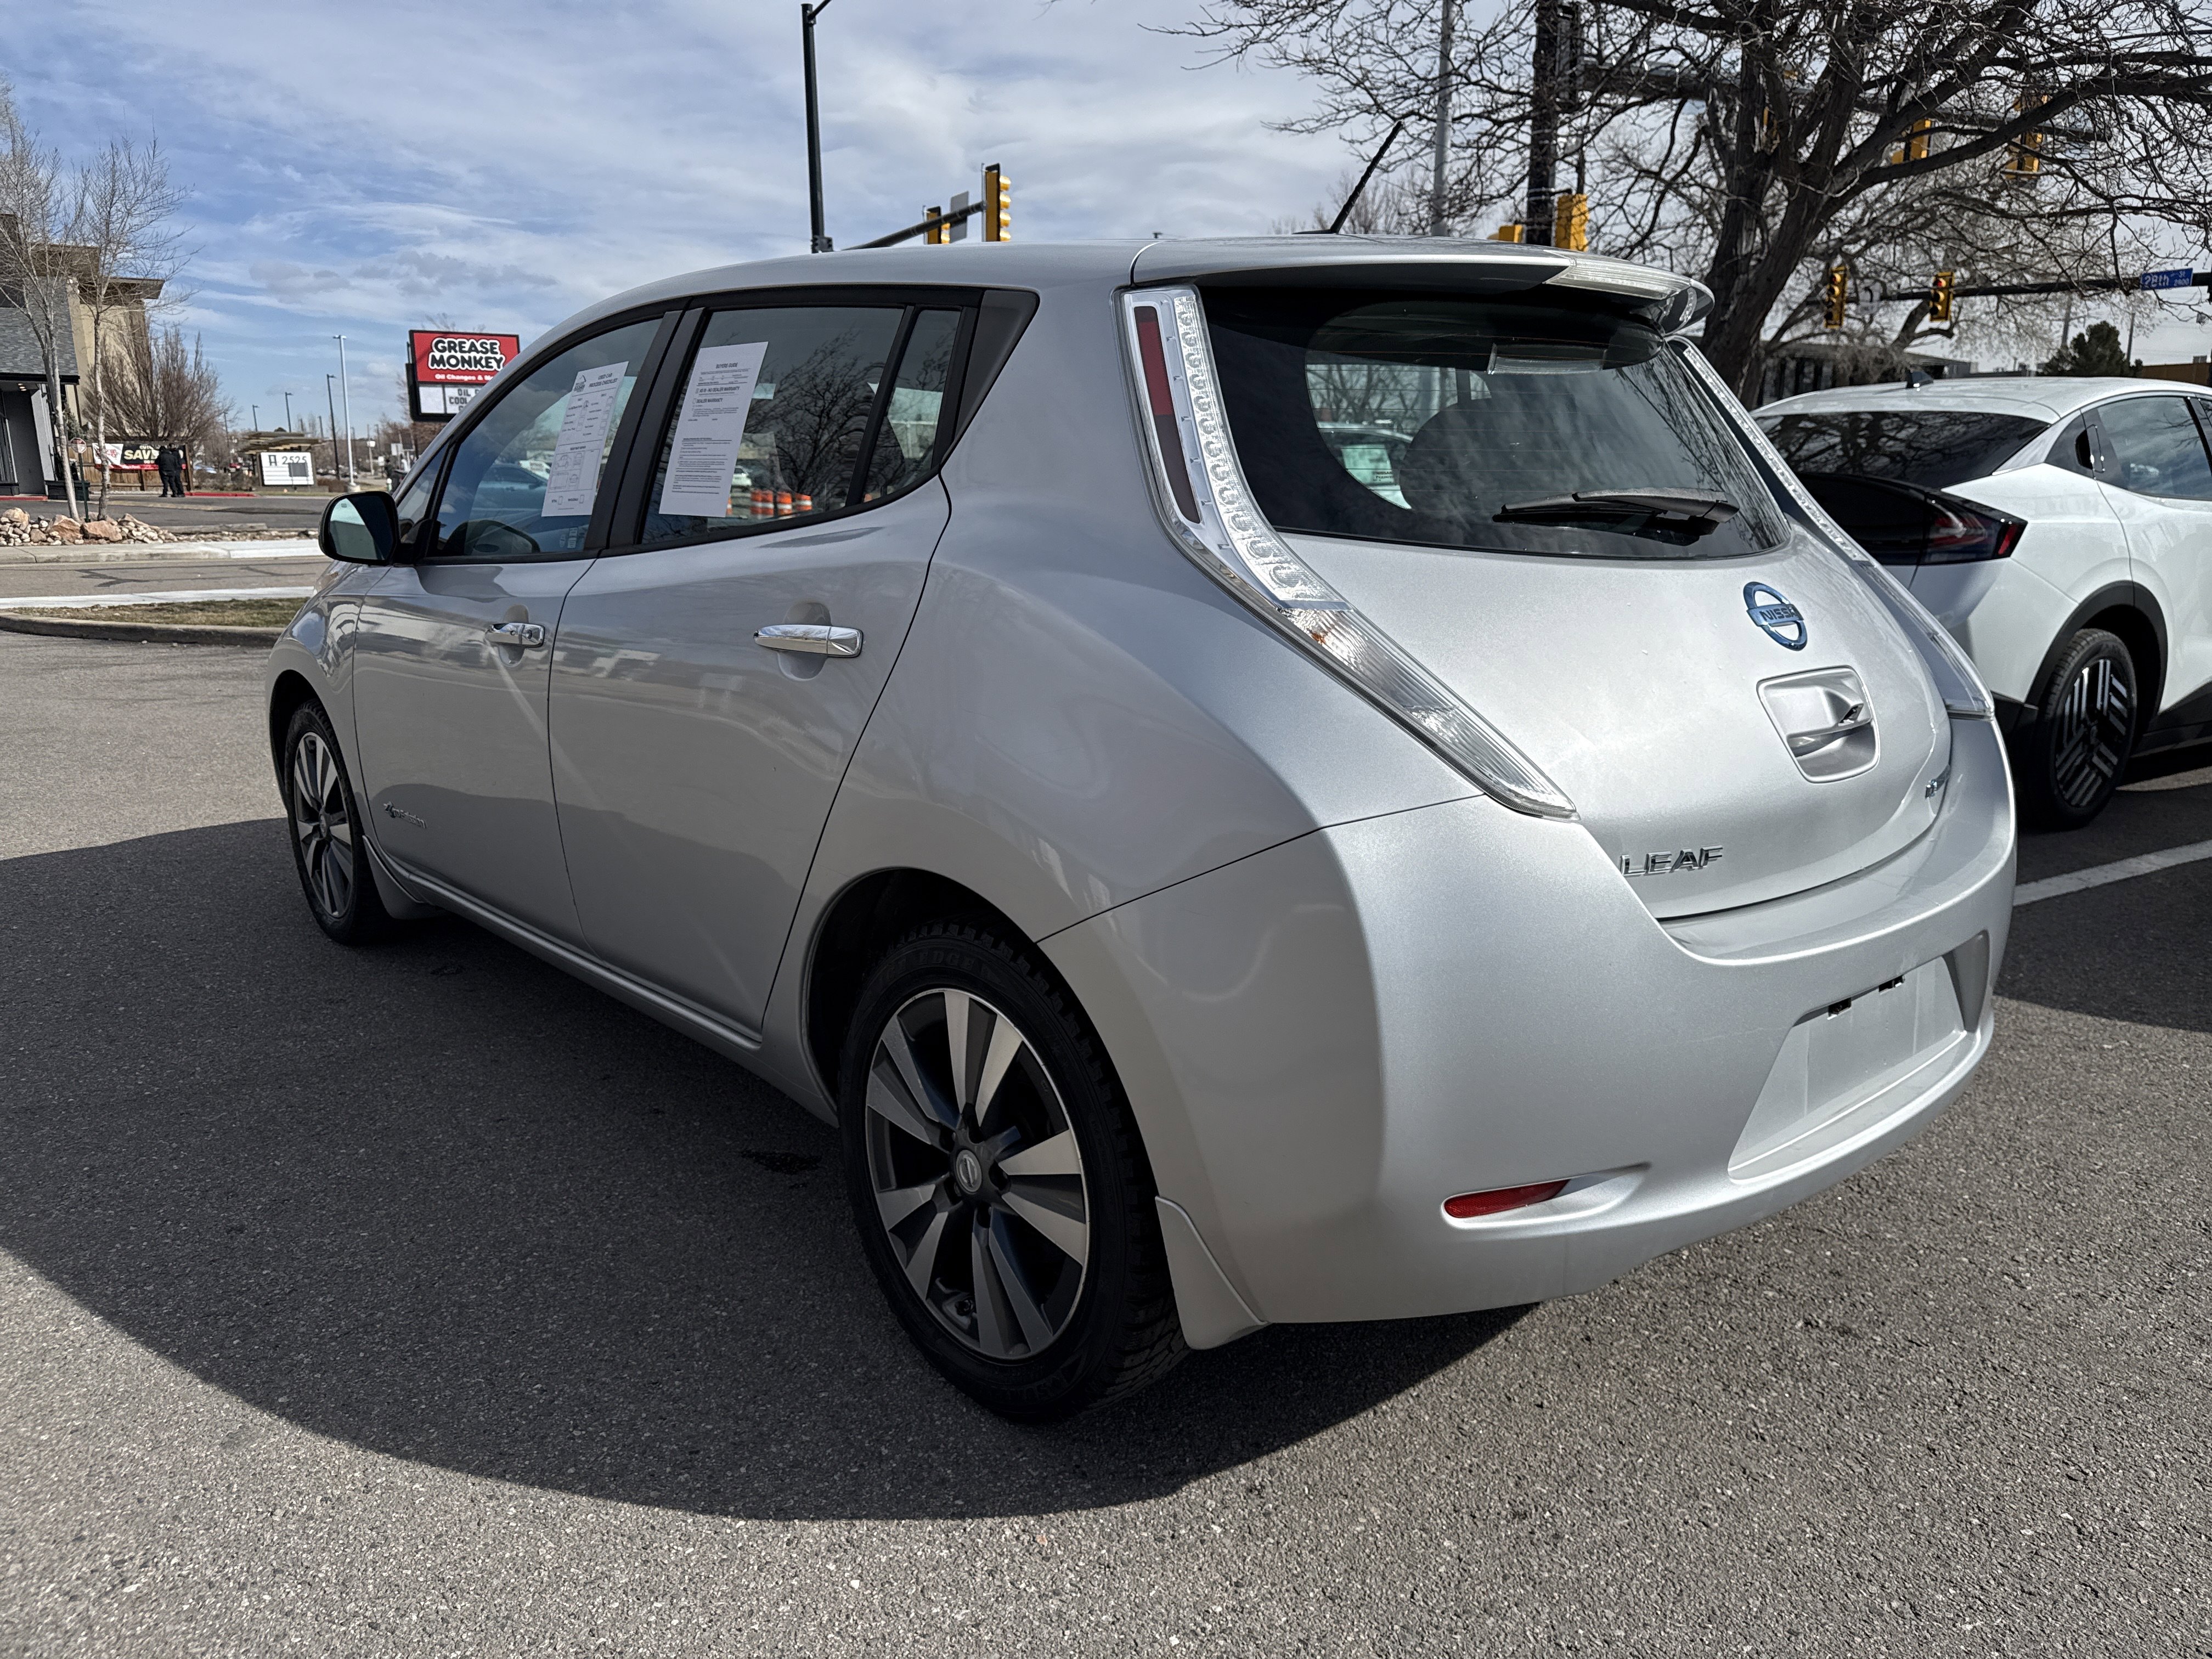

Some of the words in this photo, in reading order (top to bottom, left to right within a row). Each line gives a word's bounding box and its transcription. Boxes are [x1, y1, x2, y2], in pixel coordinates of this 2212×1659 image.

[2144, 275, 2170, 288] 28th
[434, 339, 499, 355] GREASE
[430, 354, 504, 369] MONKEY
[281, 455, 307, 465] 2525
[1759, 607, 1801, 622] NISSA
[1620, 845, 1723, 876] LEAF
